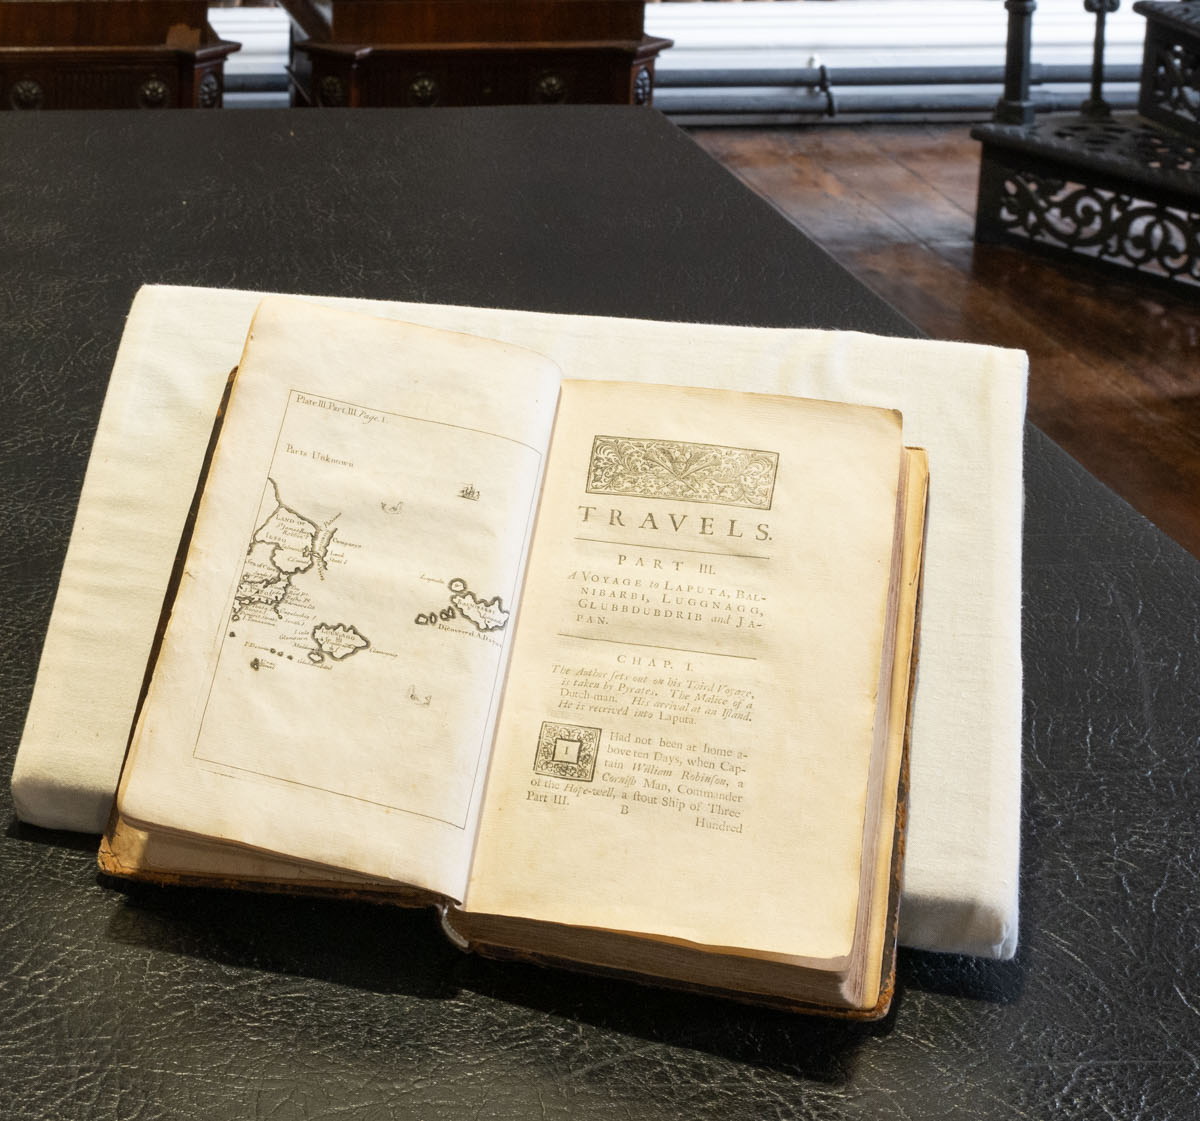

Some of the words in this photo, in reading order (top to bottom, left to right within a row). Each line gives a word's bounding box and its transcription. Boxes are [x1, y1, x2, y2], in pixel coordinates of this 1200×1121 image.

[296, 394, 318, 406] Plate
[286, 443, 308, 456] Parts
[312, 450, 354, 468] Unknown
[578, 505, 773, 541] TRAVELS.
[618, 554, 684, 572] PART
[699, 563, 716, 575] III.
[567, 570, 578, 580] A
[582, 570, 642, 587] VOYAGE
[649, 581, 659, 589] to
[578, 598, 702, 621] GLUBBDUBDRIB
[711, 614, 731, 625] and
[581, 587, 650, 603] NIBARBI,
[662, 593, 763, 617] LUGGNAGG,
[576, 614, 609, 625] PAN.
[616, 654, 673, 669] CHAP.
[686, 662, 694, 671] I.
[551, 664, 571, 674] The
[632, 675, 648, 684] out
[667, 677, 681, 687] his
[561, 677, 570, 686] is
[573, 679, 600, 688] taken
[603, 681, 613, 690] by
[618, 682, 658, 696] Pyrates.
[670, 688, 691, 701] The
[694, 693, 728, 705] Malice
[732, 698, 744, 709] of
[558, 699, 573, 709] He
[576, 701, 585, 711] is
[634, 709, 654, 719] into
[658, 711, 696, 725] Laputa.
[631, 696, 649, 707] His
[653, 700, 690, 712] arrival
[690, 705, 701, 713] at
[704, 708, 717, 716] an
[610, 731, 631, 743] Had
[634, 736, 652, 745] not
[659, 737, 683, 750] been
[686, 744, 697, 752] at
[703, 743, 733, 757] home
[737, 751, 748, 759] a-
[604, 759, 624, 769] tain
[632, 762, 673, 777] William
[607, 744, 631, 756] bove
[633, 750, 649, 759] ten
[653, 751, 683, 767] Days,
[687, 756, 715, 769] when
[720, 760, 746, 776] Cap-
[530, 779, 541, 787] of
[544, 780, 560, 790] the
[564, 783, 616, 799] Hope-well,
[621, 792, 627, 800] a
[661, 796, 686, 811] Ship
[689, 801, 702, 811] of
[707, 803, 741, 818] Three
[643, 778, 671, 793] Man,
[677, 784, 744, 803] Commander
[526, 791, 548, 802] Part
[553, 794, 570, 805] III.
[620, 804, 629, 815] B
[695, 817, 743, 834] Hundred
